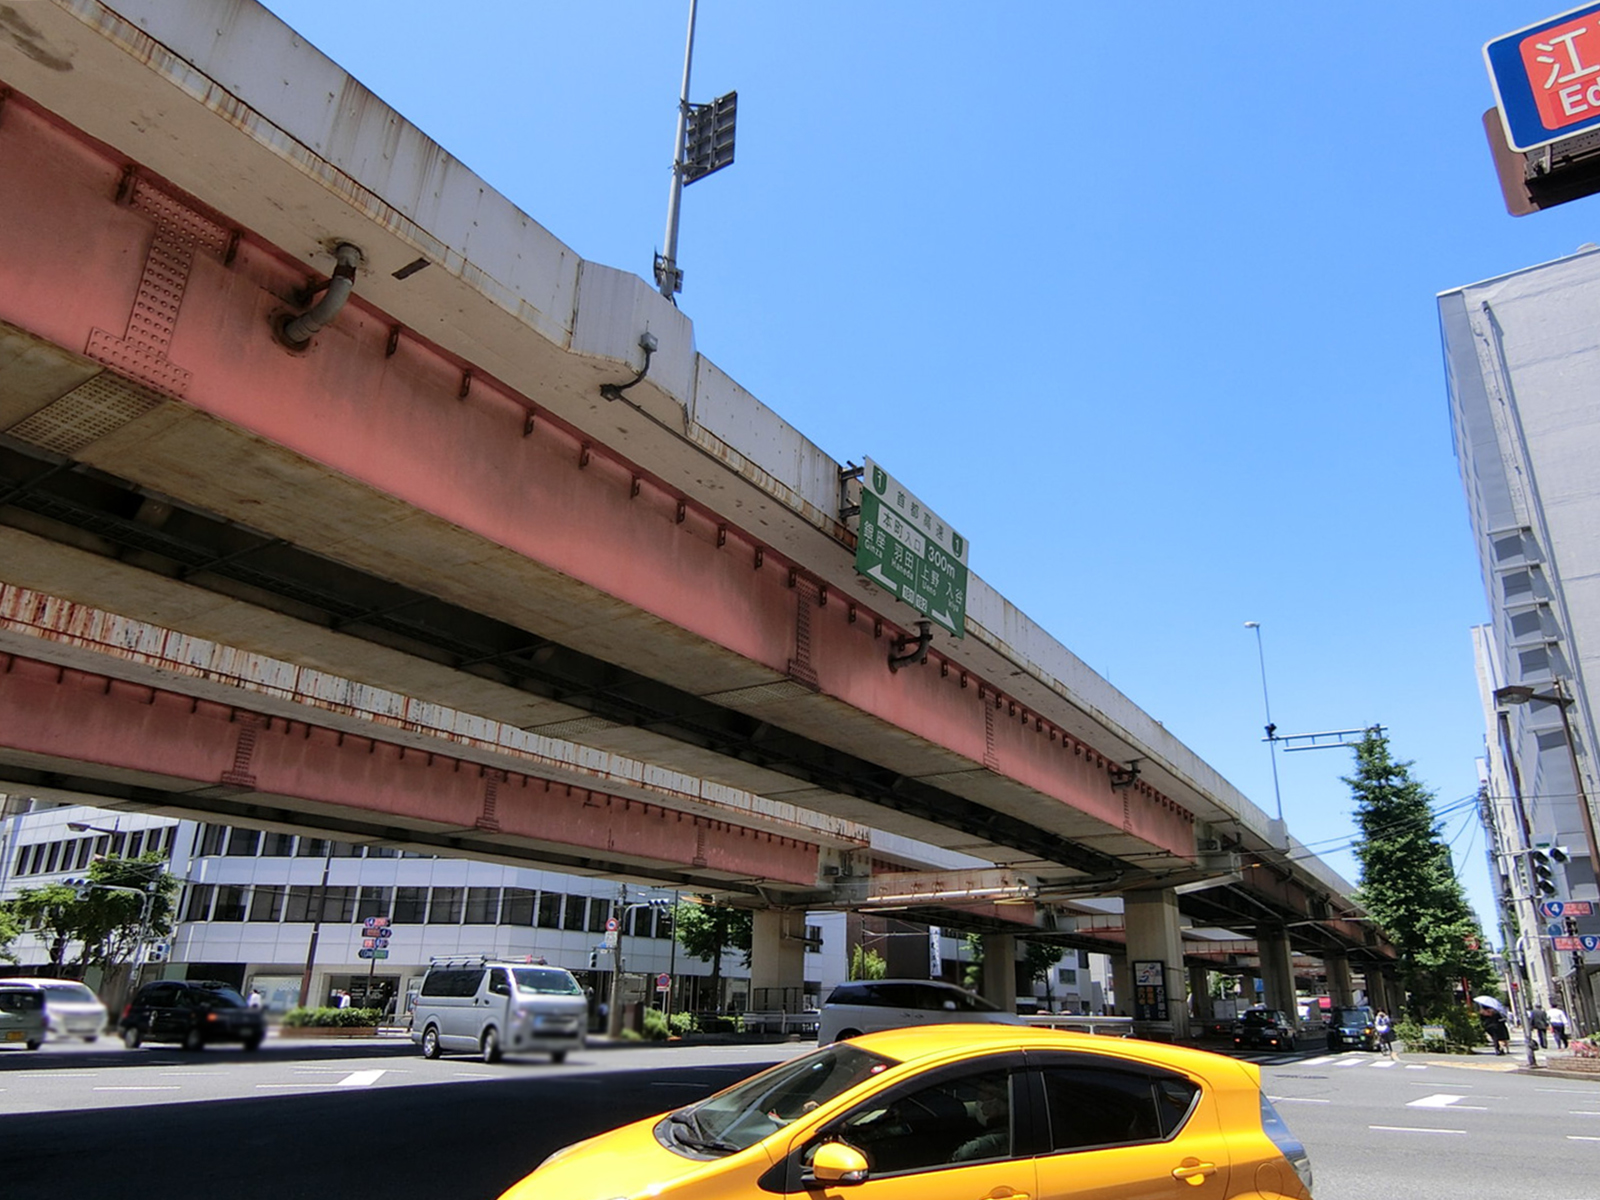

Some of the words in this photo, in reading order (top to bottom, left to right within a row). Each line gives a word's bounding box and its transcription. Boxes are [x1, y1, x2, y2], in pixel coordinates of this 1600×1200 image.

[1535, 21, 1600, 89] 江
[882, 512, 921, 551] 本町入口
[897, 491, 944, 542] 首都高速
[863, 520, 886, 550] 銀座
[894, 542, 915, 570] 羽田
[864, 539, 883, 559] Ginza
[890, 557, 914, 581] Haneda
[927, 546, 956, 579] 300m
[920, 564, 940, 588] 上野
[945, 581, 963, 605] 入谷
[921, 579, 937, 597] Ueno
[1551, 903, 1560, 914] 4
[1585, 937, 1594, 947] 6
